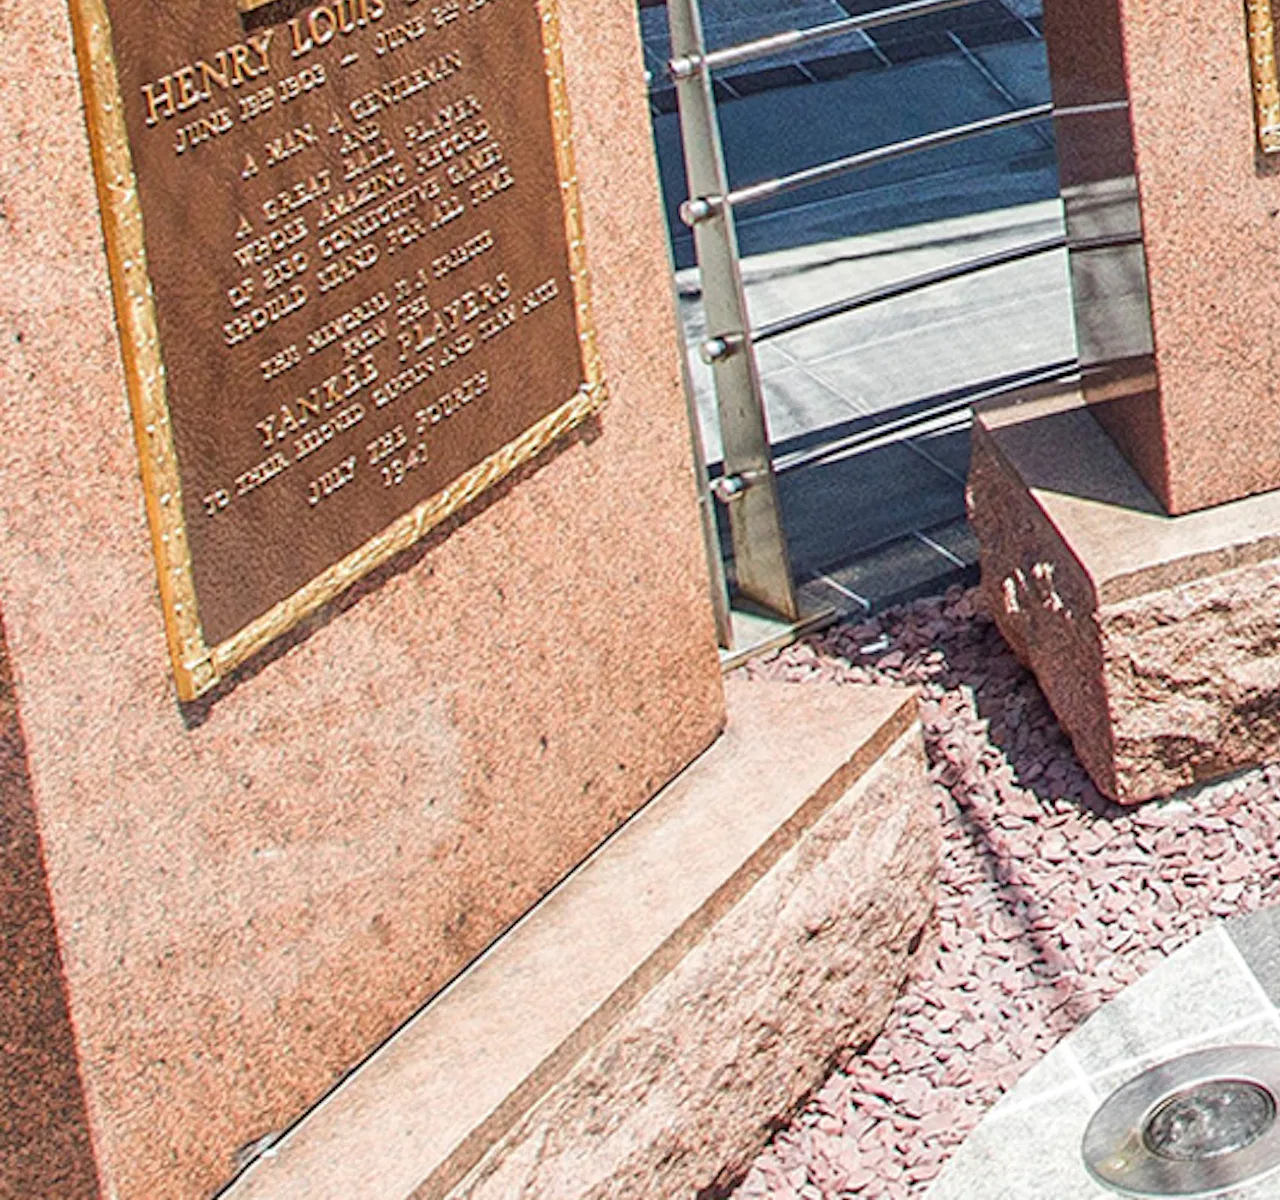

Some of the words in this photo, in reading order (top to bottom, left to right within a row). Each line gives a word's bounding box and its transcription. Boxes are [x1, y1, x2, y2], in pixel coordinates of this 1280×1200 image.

[140, 28, 275, 125] HENRY
[174, 106, 234, 154] JUNE
[374, 16, 427, 56] JUNE
[241, 152, 260, 179] A
[350, 49, 464, 120] GENTLEMAN
[256, 353, 379, 447] YANKEE
[397, 272, 511, 362] PLAYERS
